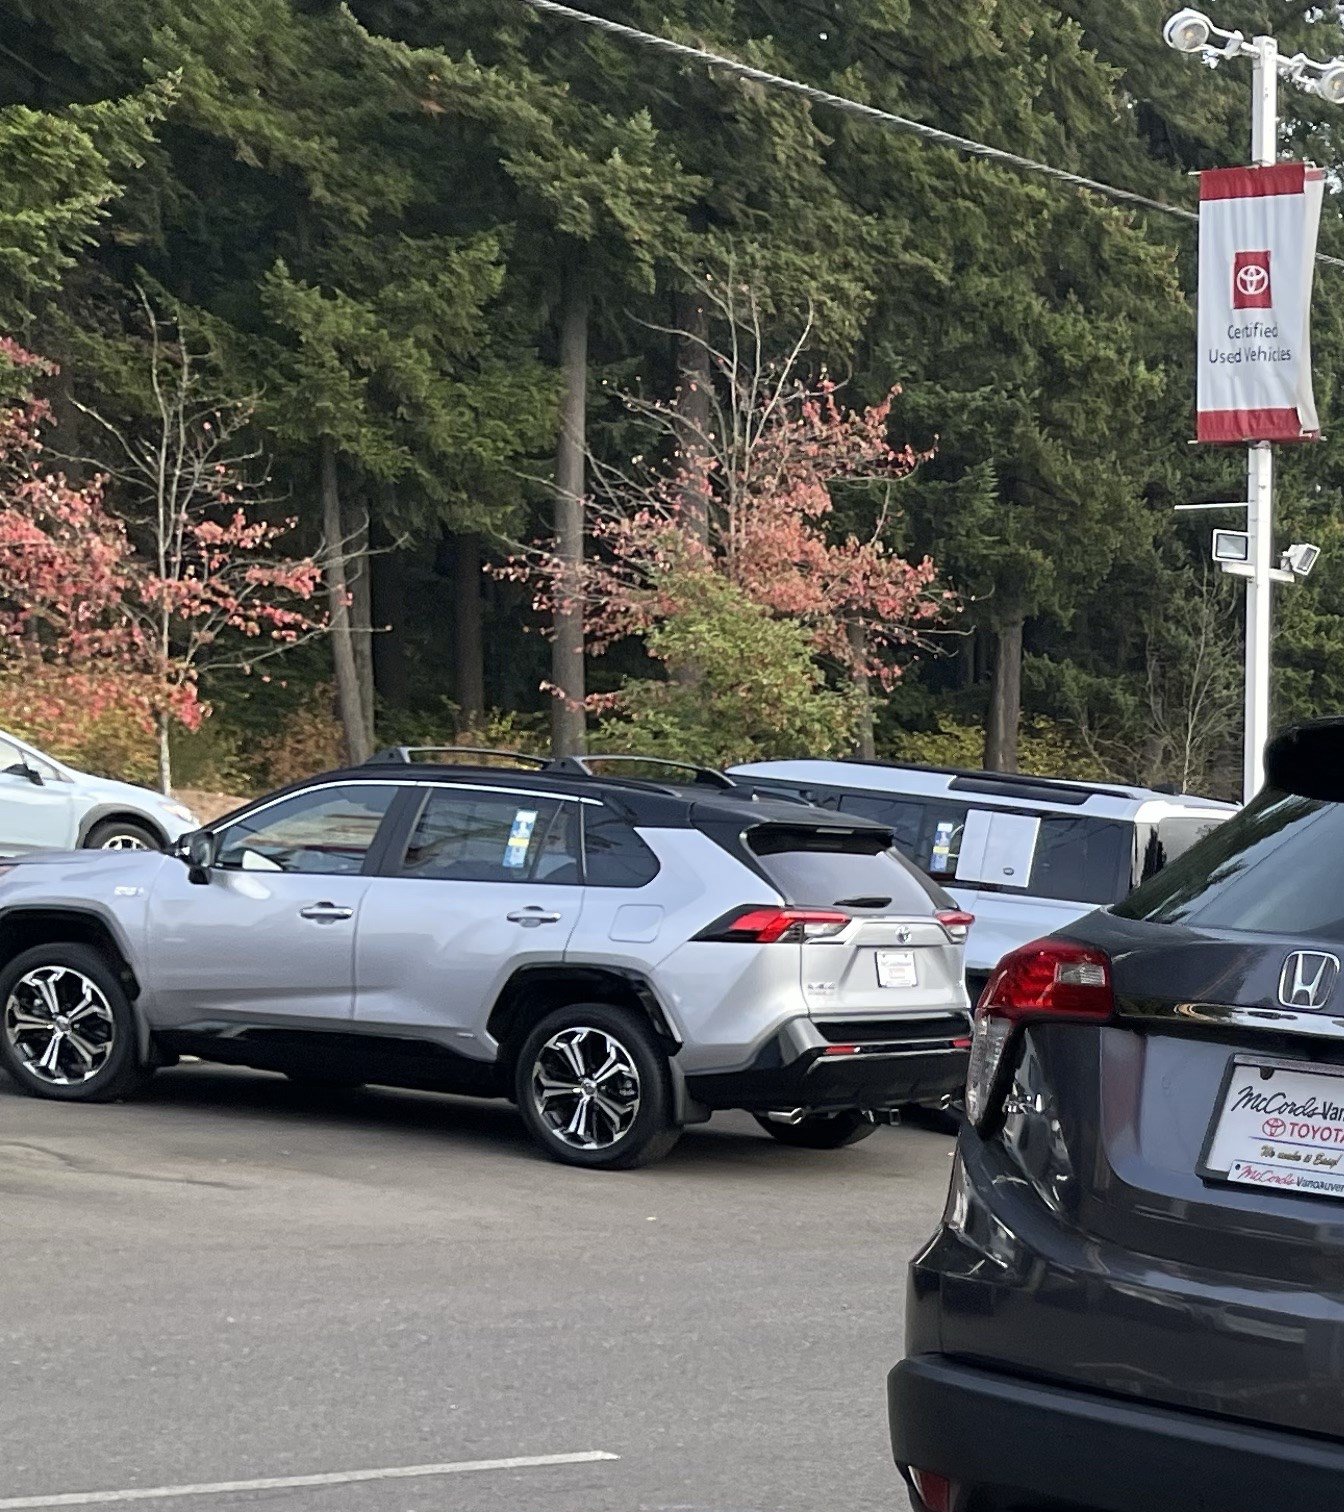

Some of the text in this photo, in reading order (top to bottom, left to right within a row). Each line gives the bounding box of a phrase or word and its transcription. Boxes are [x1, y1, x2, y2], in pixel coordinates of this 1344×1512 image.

[1227, 322, 1278, 340] Certified
[1209, 346, 1291, 364] Used Vehicles
